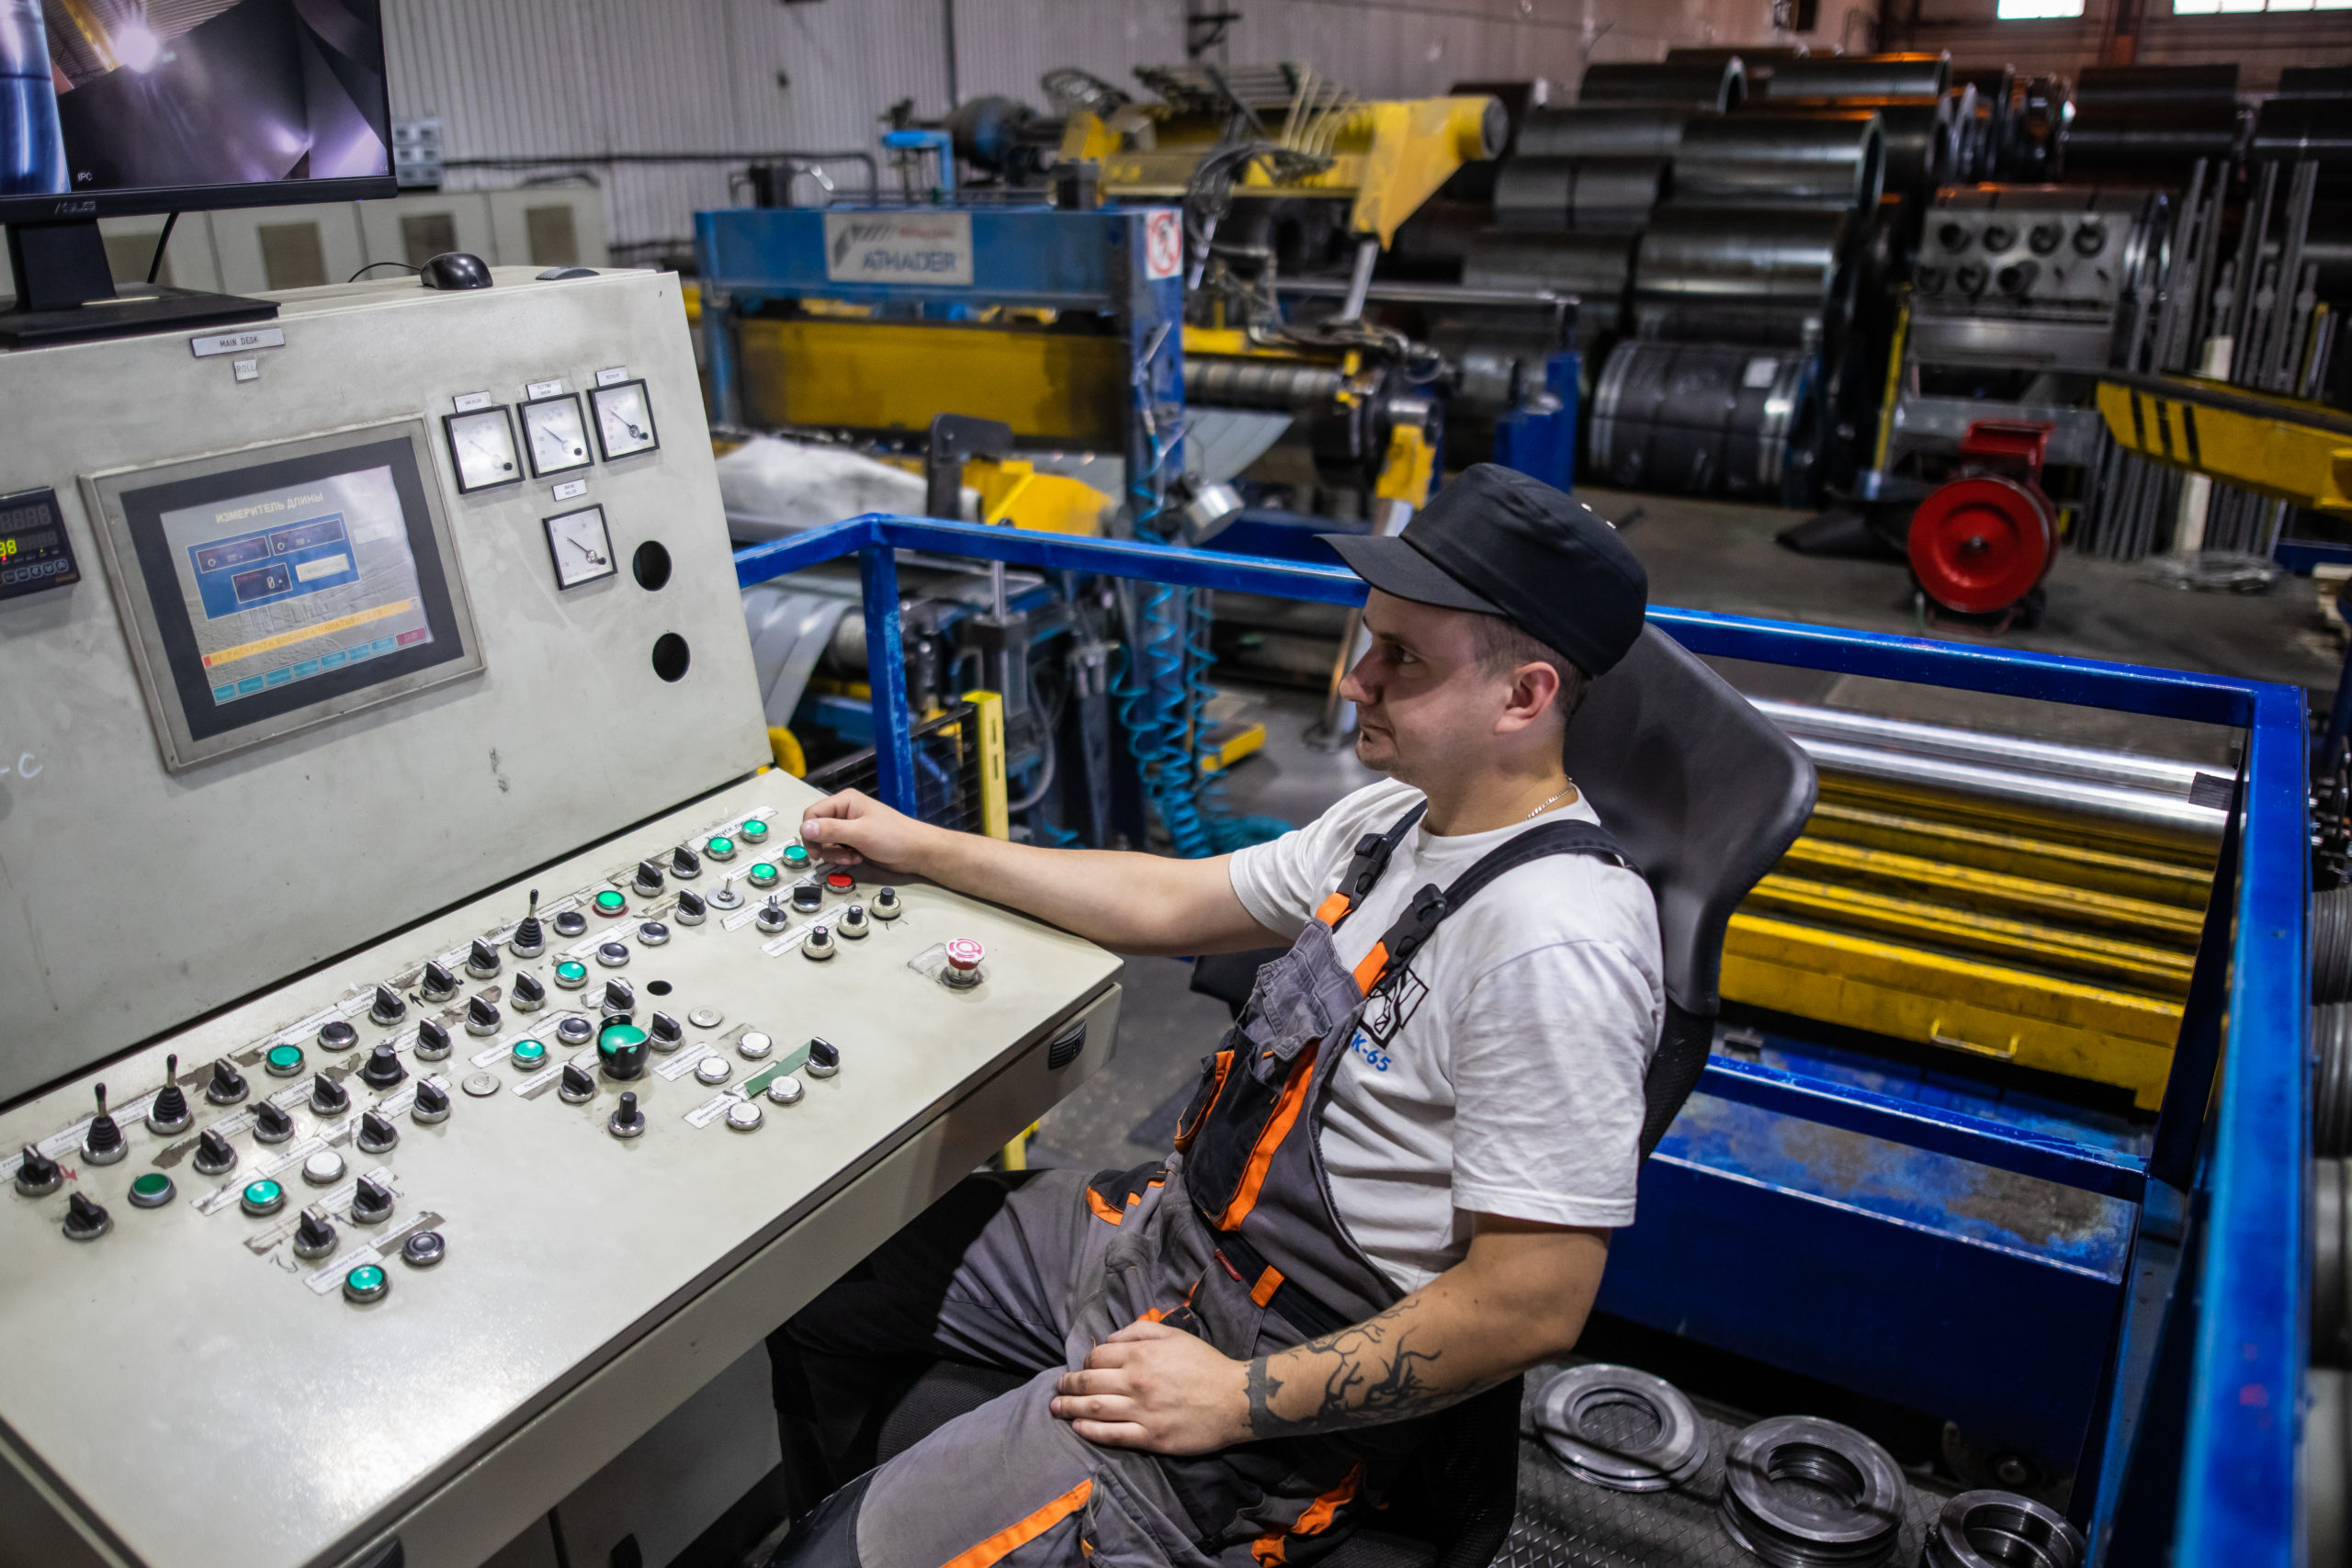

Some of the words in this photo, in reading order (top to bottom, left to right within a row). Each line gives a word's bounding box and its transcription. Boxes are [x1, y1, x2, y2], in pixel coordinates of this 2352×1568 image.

[77, 171, 93, 182] IPC
[220, 337, 238, 348] MAIN
[240, 335, 259, 346] DESK
[215, 501, 286, 525] ИЗМЕРИТЕЛЬ
[287, 491, 324, 511] ДЛИНЫ
[1351, 1030, 1392, 1073] K-65
